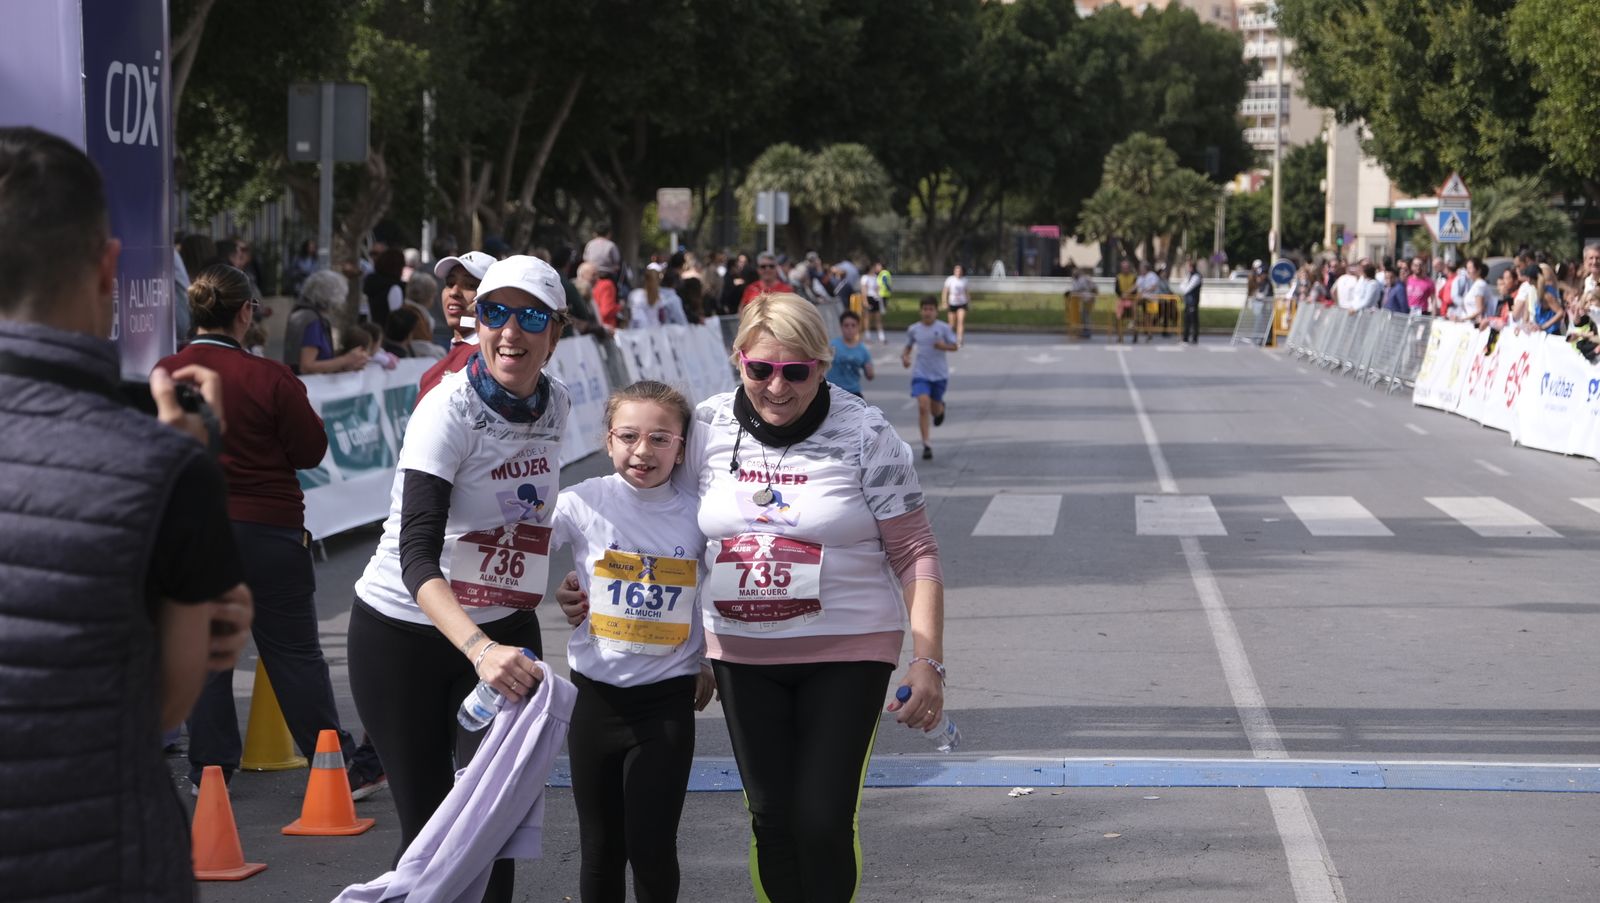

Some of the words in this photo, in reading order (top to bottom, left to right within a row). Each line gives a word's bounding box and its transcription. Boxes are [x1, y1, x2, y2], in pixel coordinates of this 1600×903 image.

[129, 313, 154, 334] CIUDAD
[491, 456, 551, 480] MUJER
[738, 468, 809, 486] MUJER
[478, 545, 526, 579] 736
[608, 562, 635, 571] MUJER
[480, 573, 498, 583] ALMA
[505, 577, 519, 586] EVA
[735, 562, 792, 589] 735
[607, 579, 683, 612] 1637
[739, 589, 759, 597] MARI
[760, 588, 788, 596] QUERO
[624, 607, 662, 618] ALMUCHI
